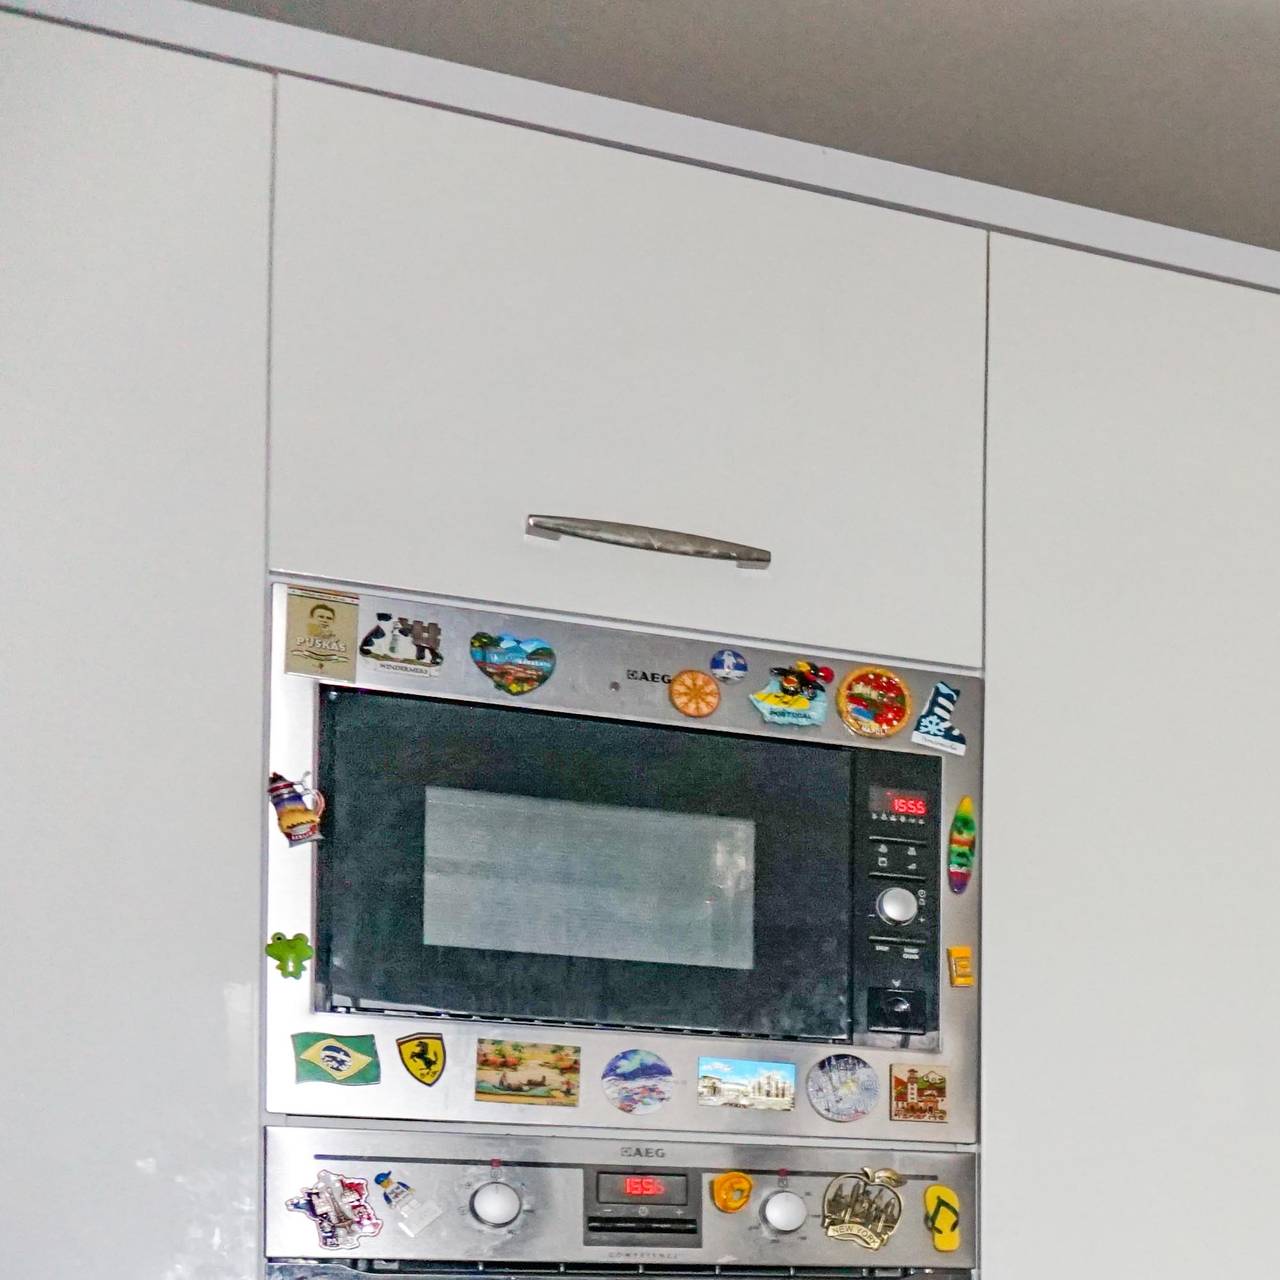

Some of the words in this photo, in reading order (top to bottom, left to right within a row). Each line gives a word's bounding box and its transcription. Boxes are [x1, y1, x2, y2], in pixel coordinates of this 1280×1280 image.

[639, 671, 673, 685] AEG
[633, 1147, 665, 1158] AEG
[831, 1225, 852, 1236] NEW
[853, 1225, 880, 1246] YORK
